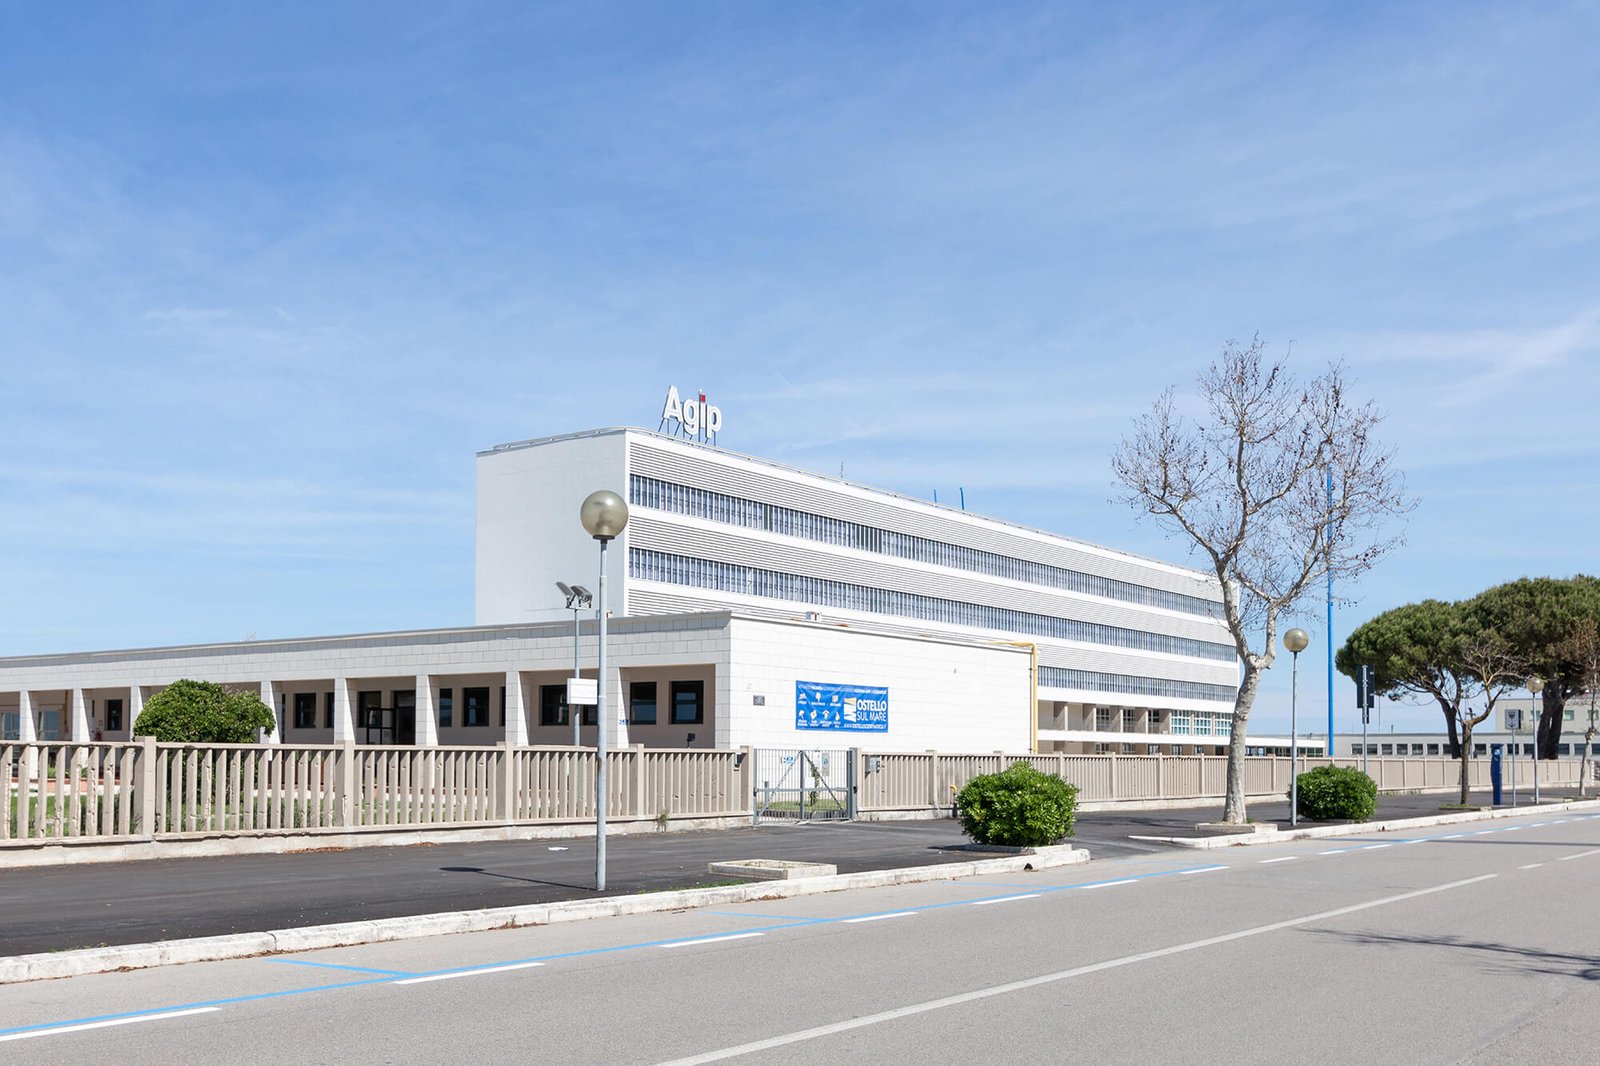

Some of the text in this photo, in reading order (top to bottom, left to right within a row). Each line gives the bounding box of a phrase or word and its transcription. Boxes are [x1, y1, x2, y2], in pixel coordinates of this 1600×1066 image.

[662, 384, 722, 439] Agip
[857, 699, 887, 711] OSTELLO
[857, 711, 886, 722] SUL MARE
